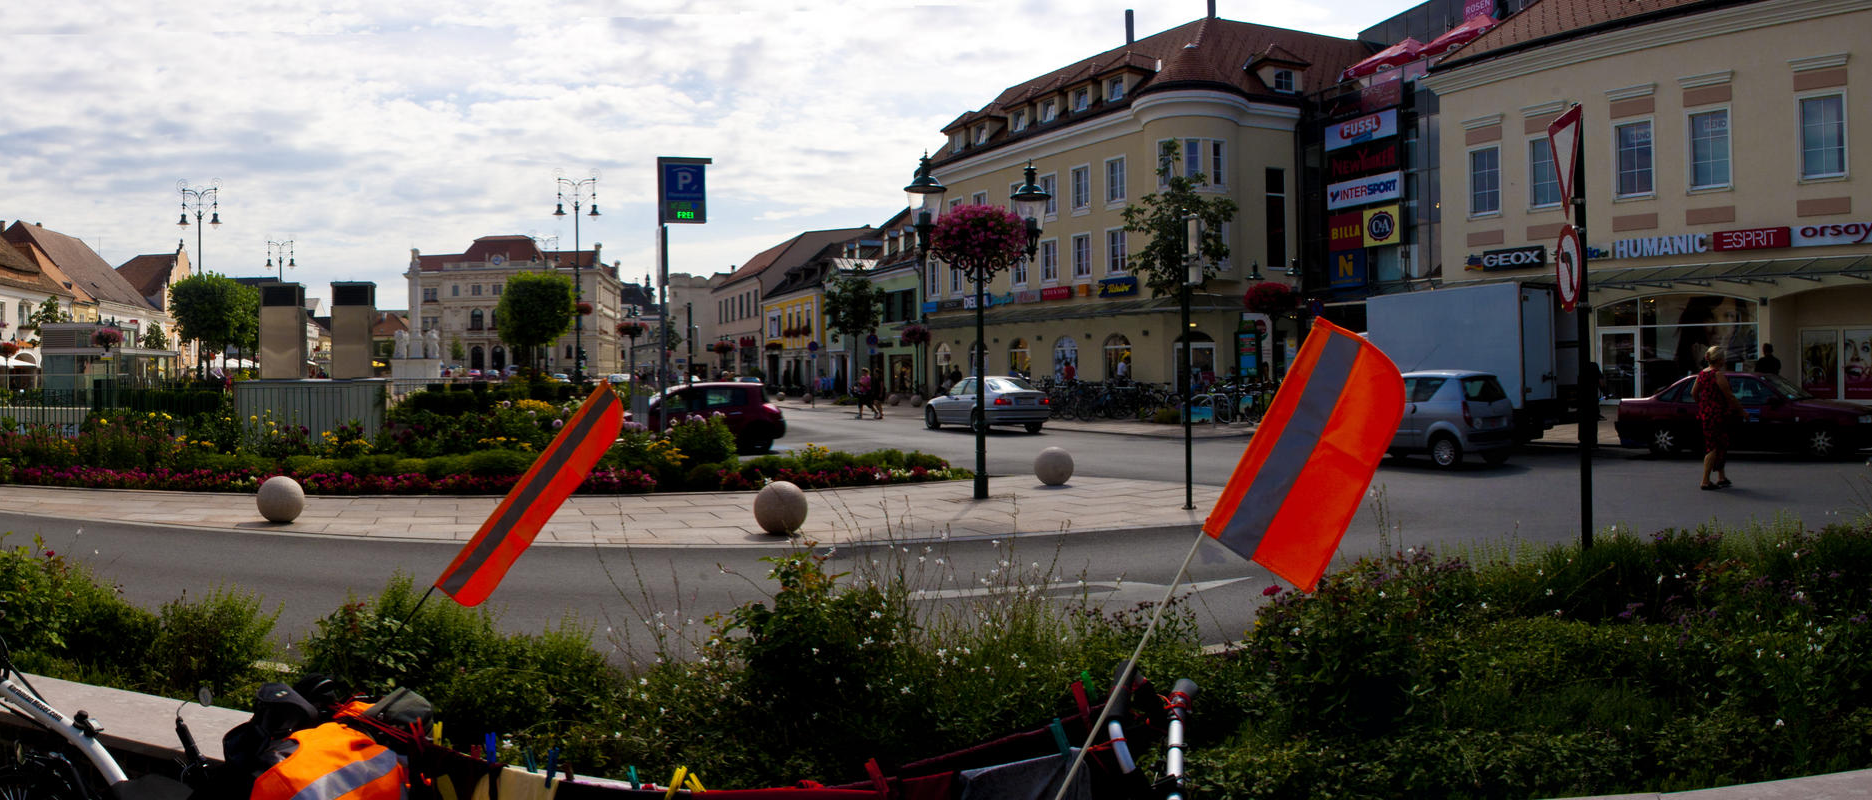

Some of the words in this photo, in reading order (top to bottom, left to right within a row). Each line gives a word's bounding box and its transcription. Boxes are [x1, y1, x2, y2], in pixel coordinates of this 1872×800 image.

[1343, 116, 1378, 137] FUSSL
[678, 171, 693, 191] P
[1340, 178, 1397, 201] INTERSPORT
[677, 210, 695, 220] FREI
[1331, 224, 1361, 241] BILLA
[1723, 229, 1778, 249] ESPRIT
[1615, 232, 1708, 260] HUMANIC
[1483, 249, 1542, 268] GEOX
